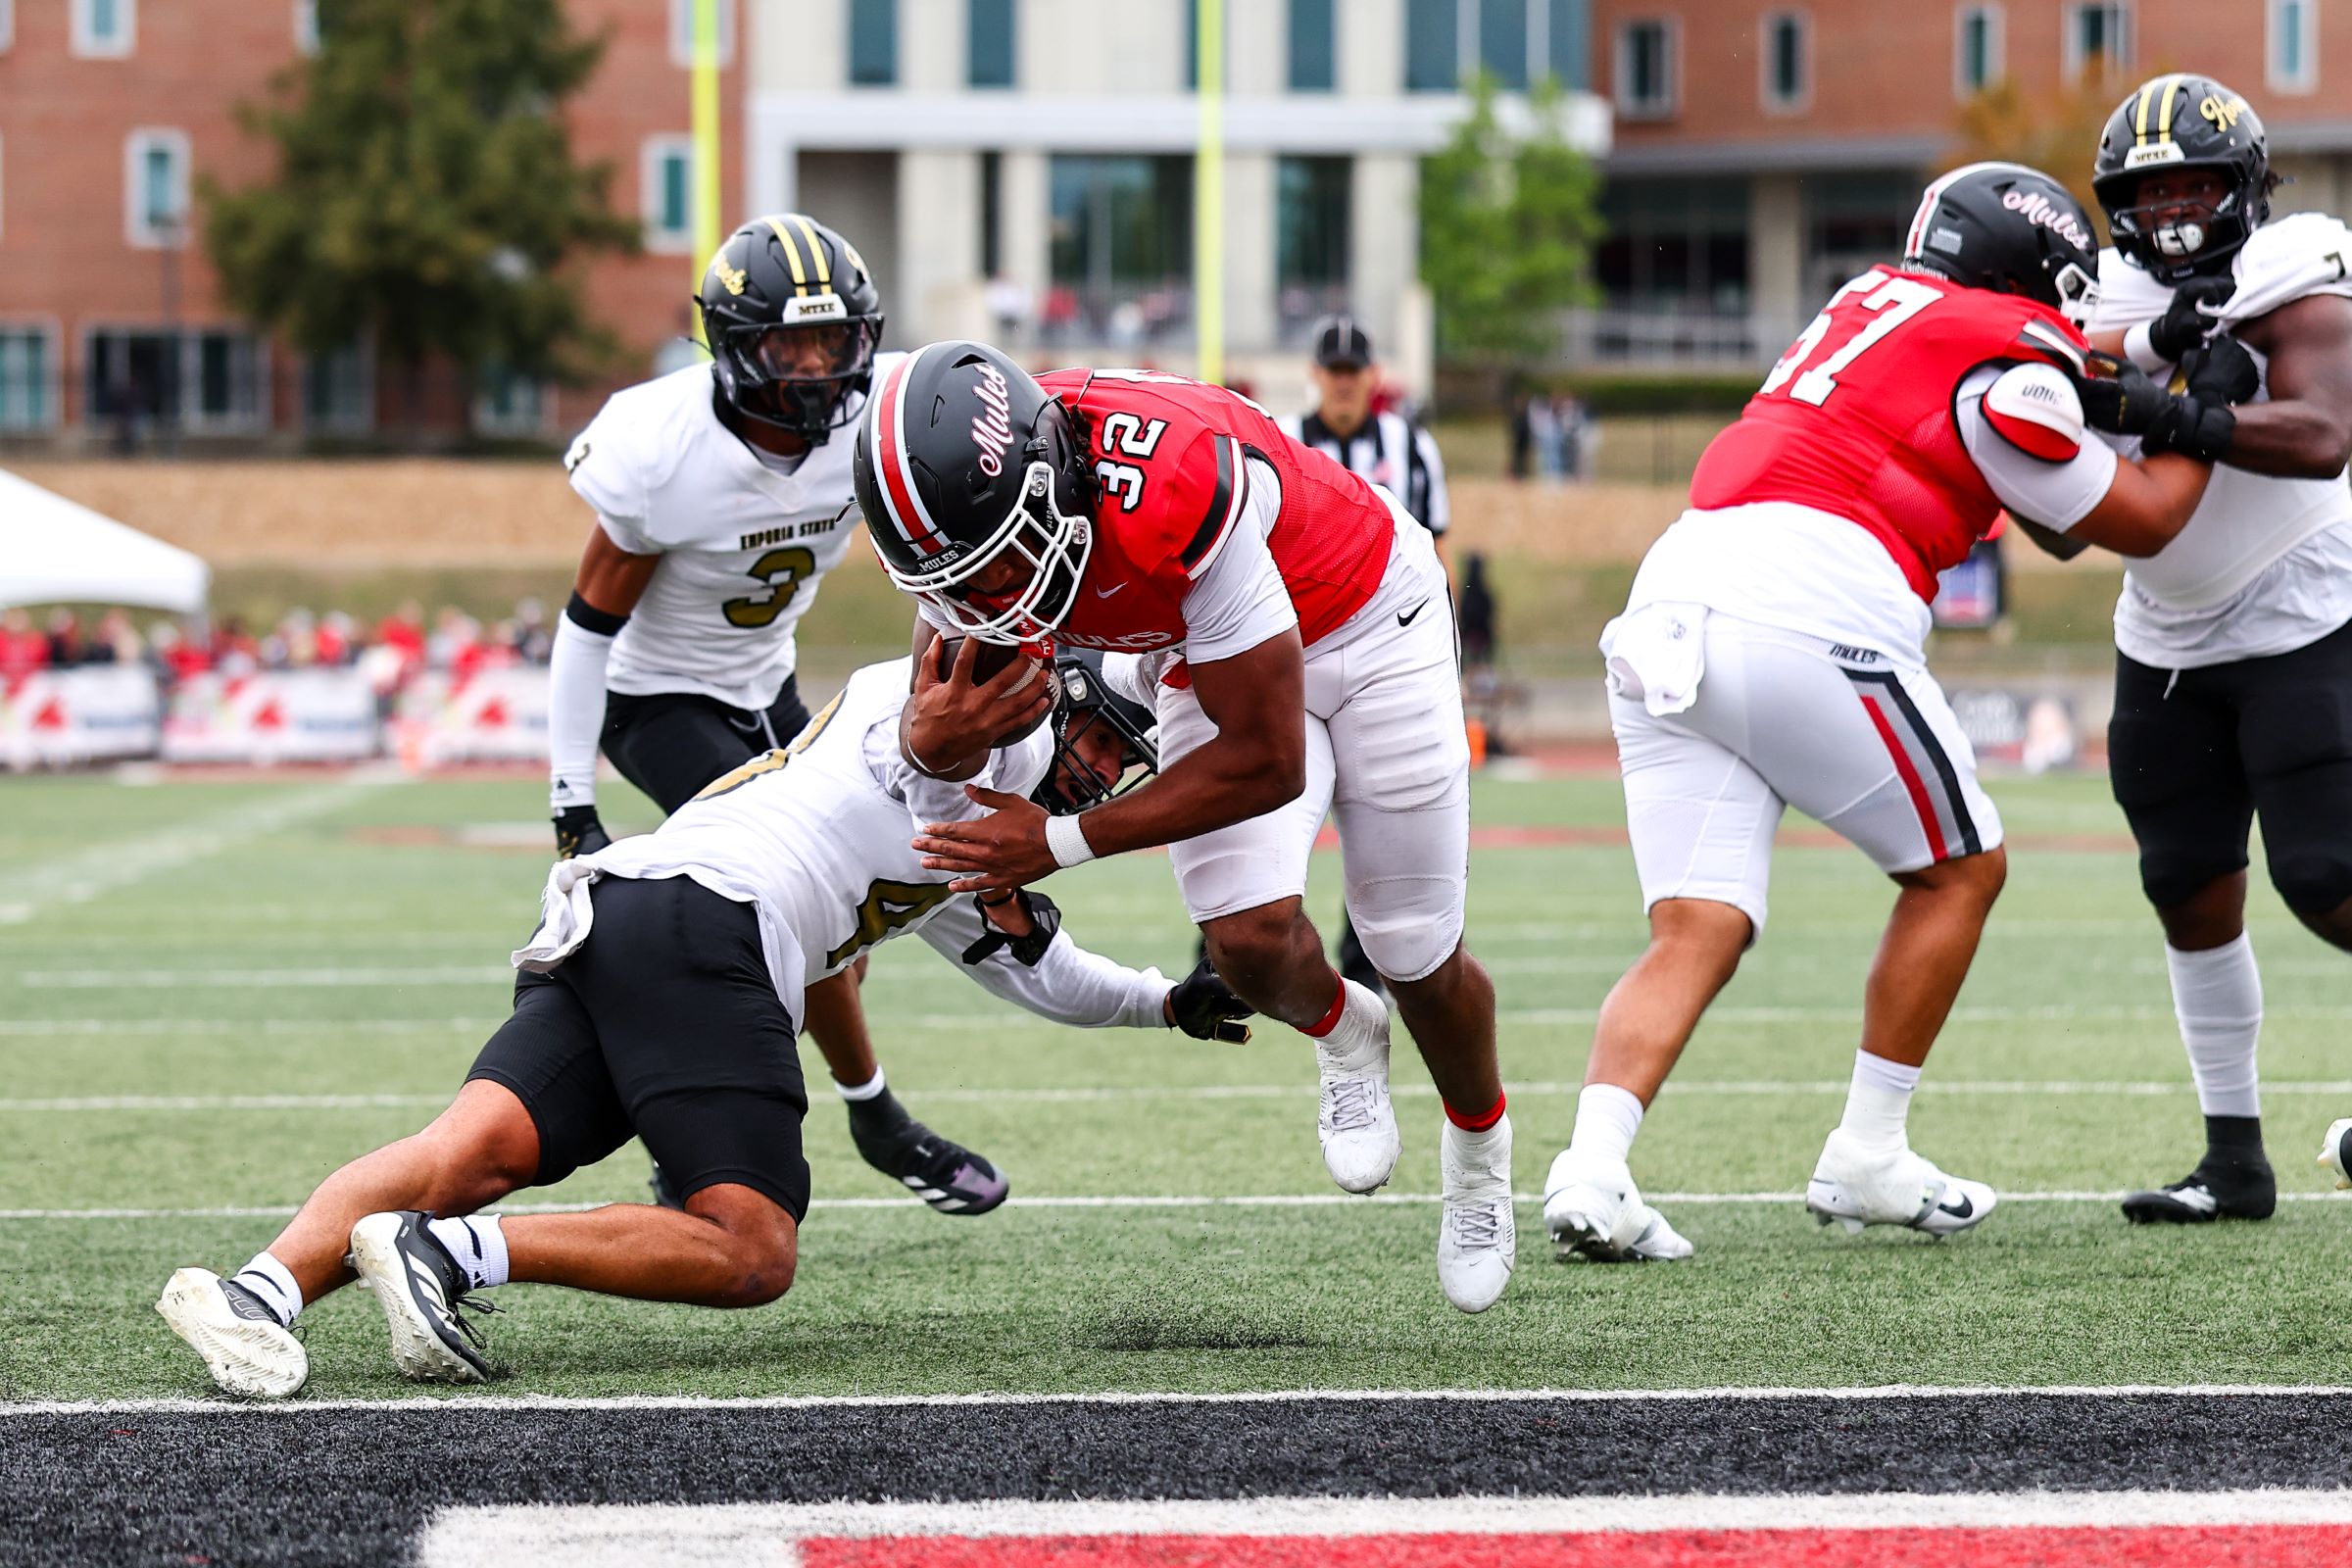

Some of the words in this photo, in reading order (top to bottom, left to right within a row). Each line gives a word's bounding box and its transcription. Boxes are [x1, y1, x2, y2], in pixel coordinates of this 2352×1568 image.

[2002, 191, 2089, 250] Mules
[799, 303, 835, 317] MTXE
[1757, 270, 1944, 408] 57
[971, 362, 1014, 477] Mules
[1094, 411, 1171, 514] 32
[740, 524, 795, 551] EMPORIA
[799, 517, 836, 538] STATE
[918, 549, 959, 572] MULES
[721, 546, 816, 629] 3
